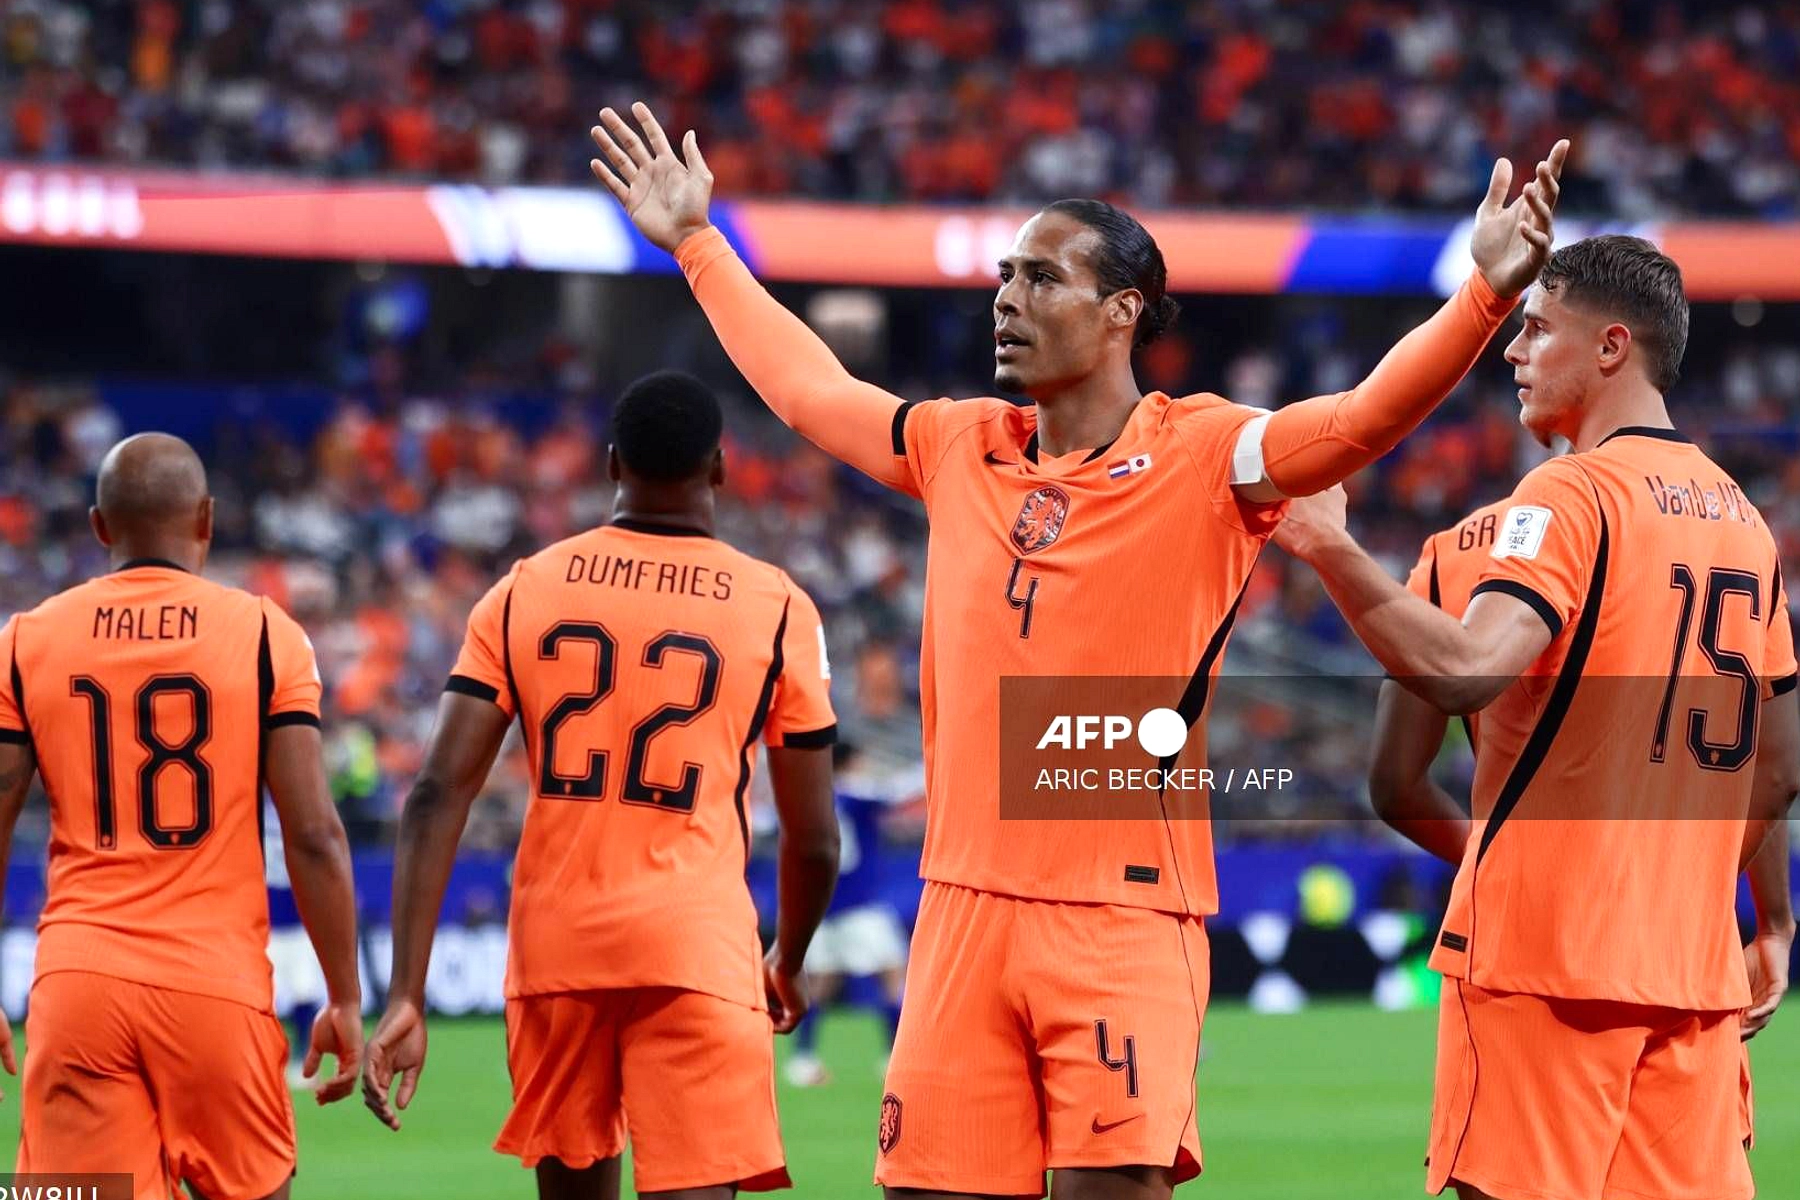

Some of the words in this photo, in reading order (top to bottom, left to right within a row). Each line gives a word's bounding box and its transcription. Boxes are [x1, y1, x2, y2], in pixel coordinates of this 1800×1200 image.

[566, 554, 732, 600] DUMFRIES
[1005, 556, 1040, 639] 4
[93, 605, 198, 640] MALEN
[1650, 563, 1761, 773] 15
[537, 619, 725, 814] 22
[69, 673, 213, 850] 18
[1094, 1018, 1139, 1098] 4
